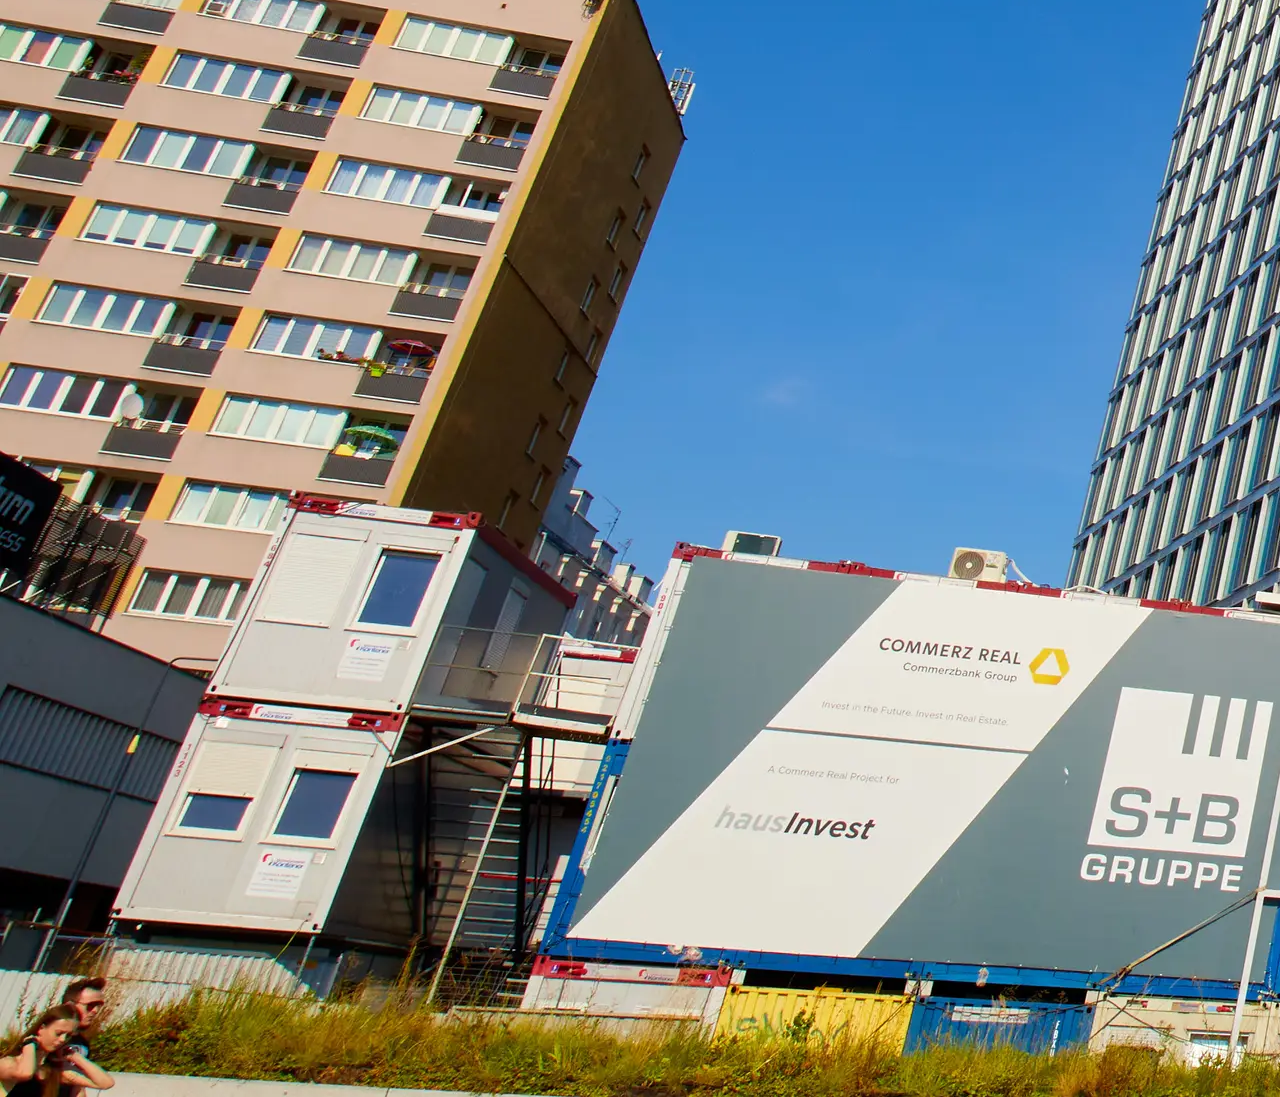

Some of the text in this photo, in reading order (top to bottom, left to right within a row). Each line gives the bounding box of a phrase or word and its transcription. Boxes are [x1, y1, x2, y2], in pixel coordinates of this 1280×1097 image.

[879, 638, 1022, 665] COMMERZ REAL
[903, 662, 1018, 684] Commerzbank Group
[821, 700, 850, 711] Invest
[852, 704, 860, 712] in
[863, 705, 879, 714] the
[915, 710, 944, 720] Invest
[945, 713, 954, 722] in
[956, 713, 976, 723] Real
[767, 765, 900, 785] A Commerz Real Project for
[714, 805, 876, 840] hausInvest
[1105, 786, 1240, 845] S+B
[1080, 853, 1243, 892] GRUPPE
